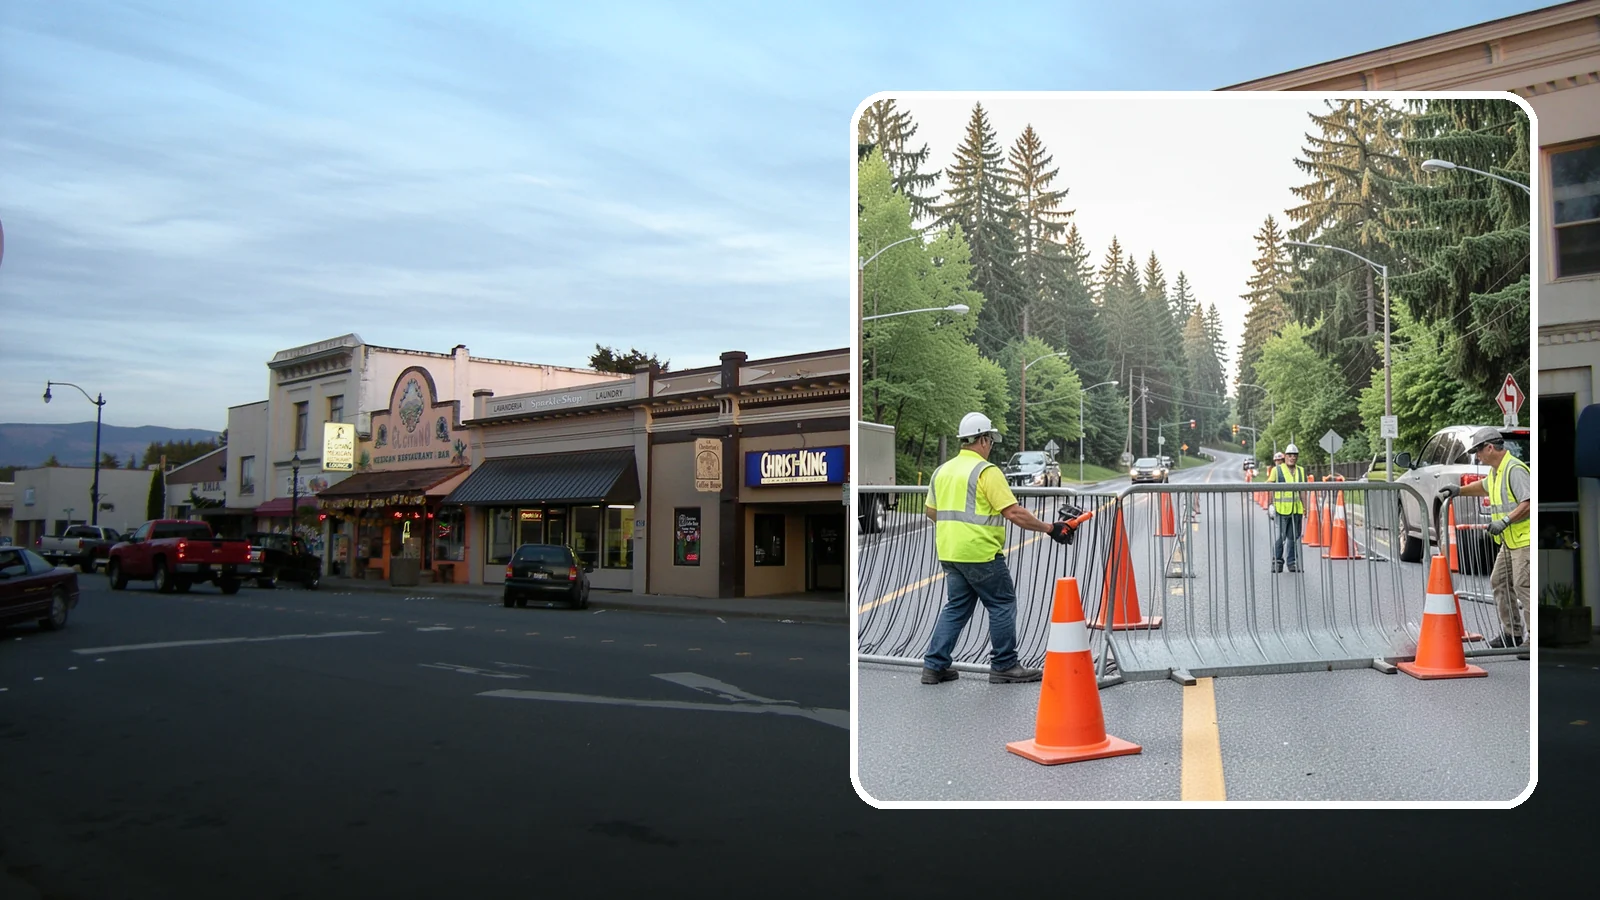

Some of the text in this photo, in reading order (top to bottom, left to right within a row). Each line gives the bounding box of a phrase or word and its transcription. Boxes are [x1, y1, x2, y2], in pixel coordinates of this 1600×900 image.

[595, 389, 624, 400] LAUNDRY
[530, 394, 582, 409] Sparkle Shop
[493, 403, 523, 413] LAVANDERIA
[373, 454, 396, 464] MEXICAN
[397, 451, 434, 462] RESTAURANT
[438, 450, 450, 459] BAR
[761, 450, 827, 478] CHRIST KING
[696, 481, 709, 489] Coffee
